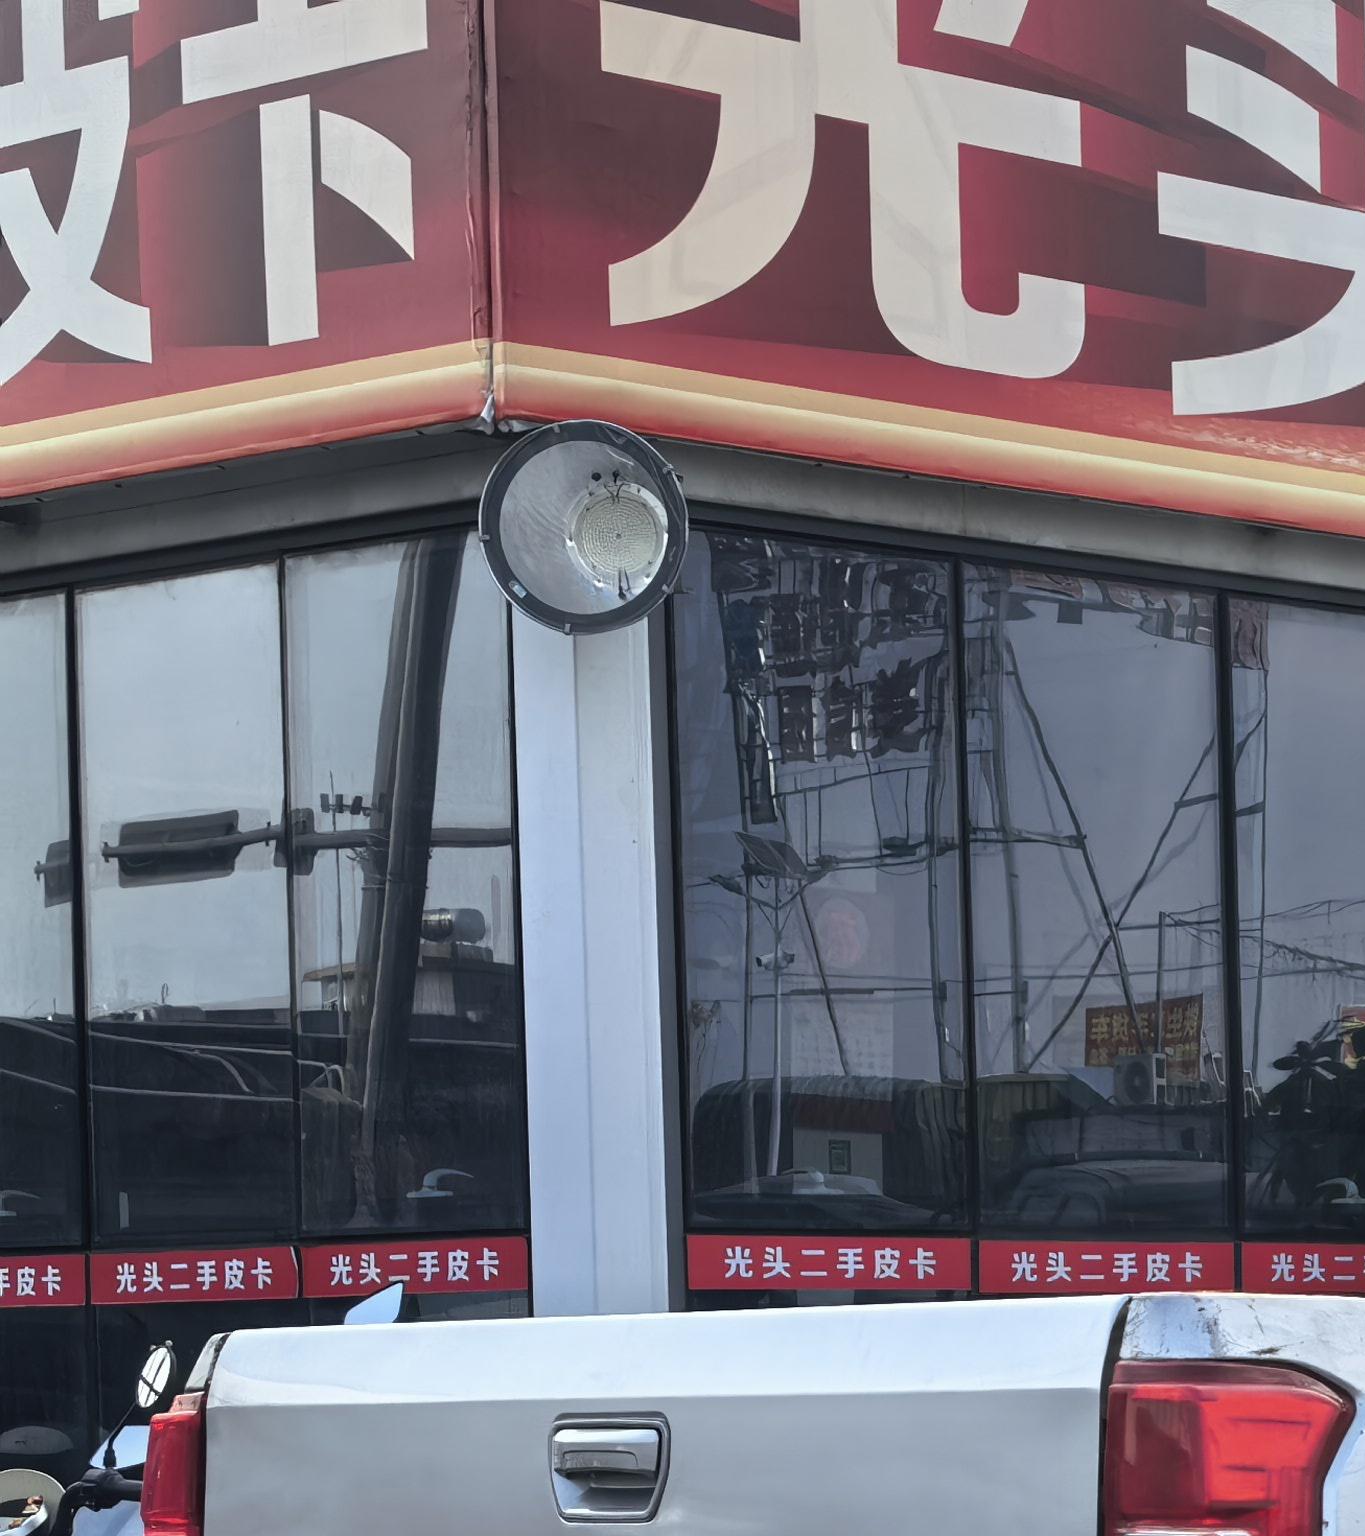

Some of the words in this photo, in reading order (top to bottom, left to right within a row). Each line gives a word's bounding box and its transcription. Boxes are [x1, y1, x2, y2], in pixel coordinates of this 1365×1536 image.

[116, 1257, 273, 1294] 光头二手皮卡
[330, 1248, 499, 1286] 光头二手皮卡
[724, 1246, 938, 1280] 光头二手皮卡
[1011, 1250, 1203, 1284] 光头二手皮卡
